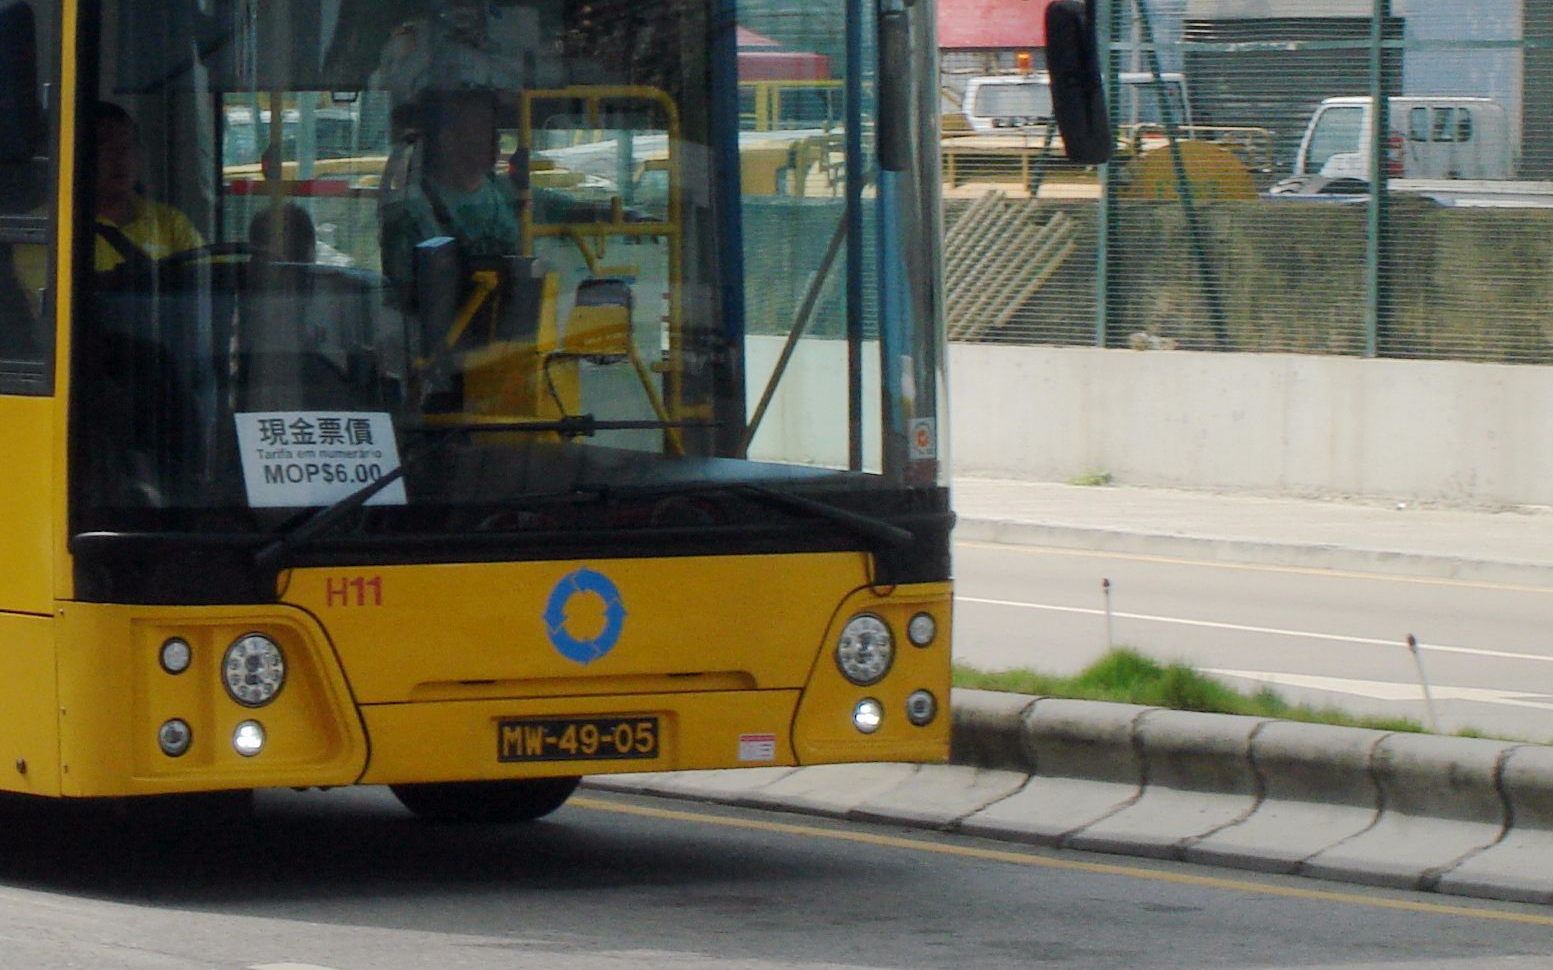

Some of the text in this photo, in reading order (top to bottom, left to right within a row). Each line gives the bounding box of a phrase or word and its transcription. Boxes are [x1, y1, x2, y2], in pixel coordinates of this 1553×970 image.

[256, 416, 375, 447] 現金票價
[263, 463, 382, 485] MOP$6.00
[325, 576, 383, 607] H11
[501, 722, 655, 758] MW-49-05
